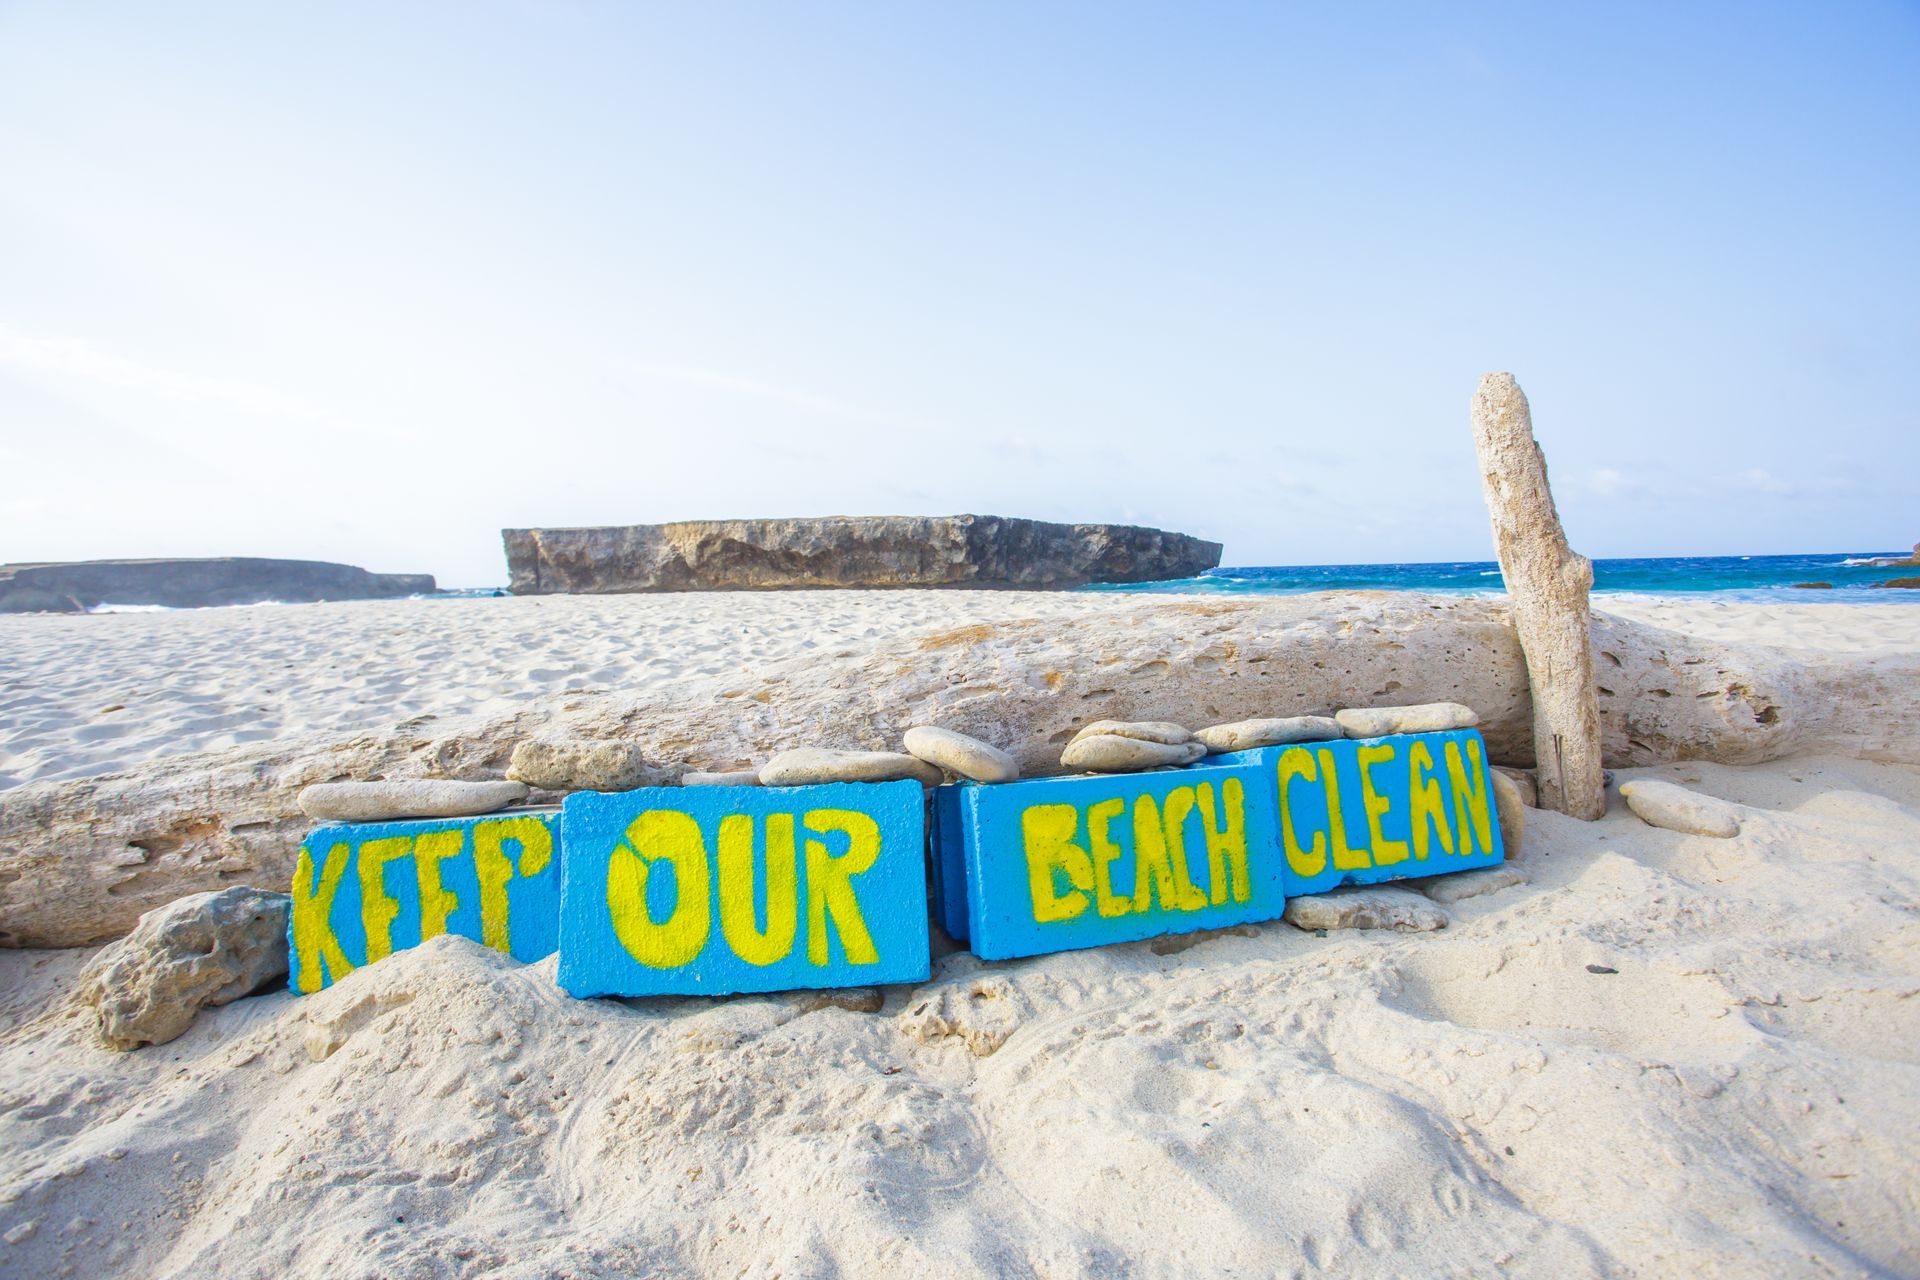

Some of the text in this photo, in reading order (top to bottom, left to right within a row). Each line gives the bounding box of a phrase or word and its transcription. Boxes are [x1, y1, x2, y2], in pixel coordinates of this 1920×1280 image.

[1021, 777, 1250, 923] BEACH
[1277, 739, 1493, 877] CLEAN
[290, 816, 553, 994] KEEP
[607, 809, 882, 968] OUR
